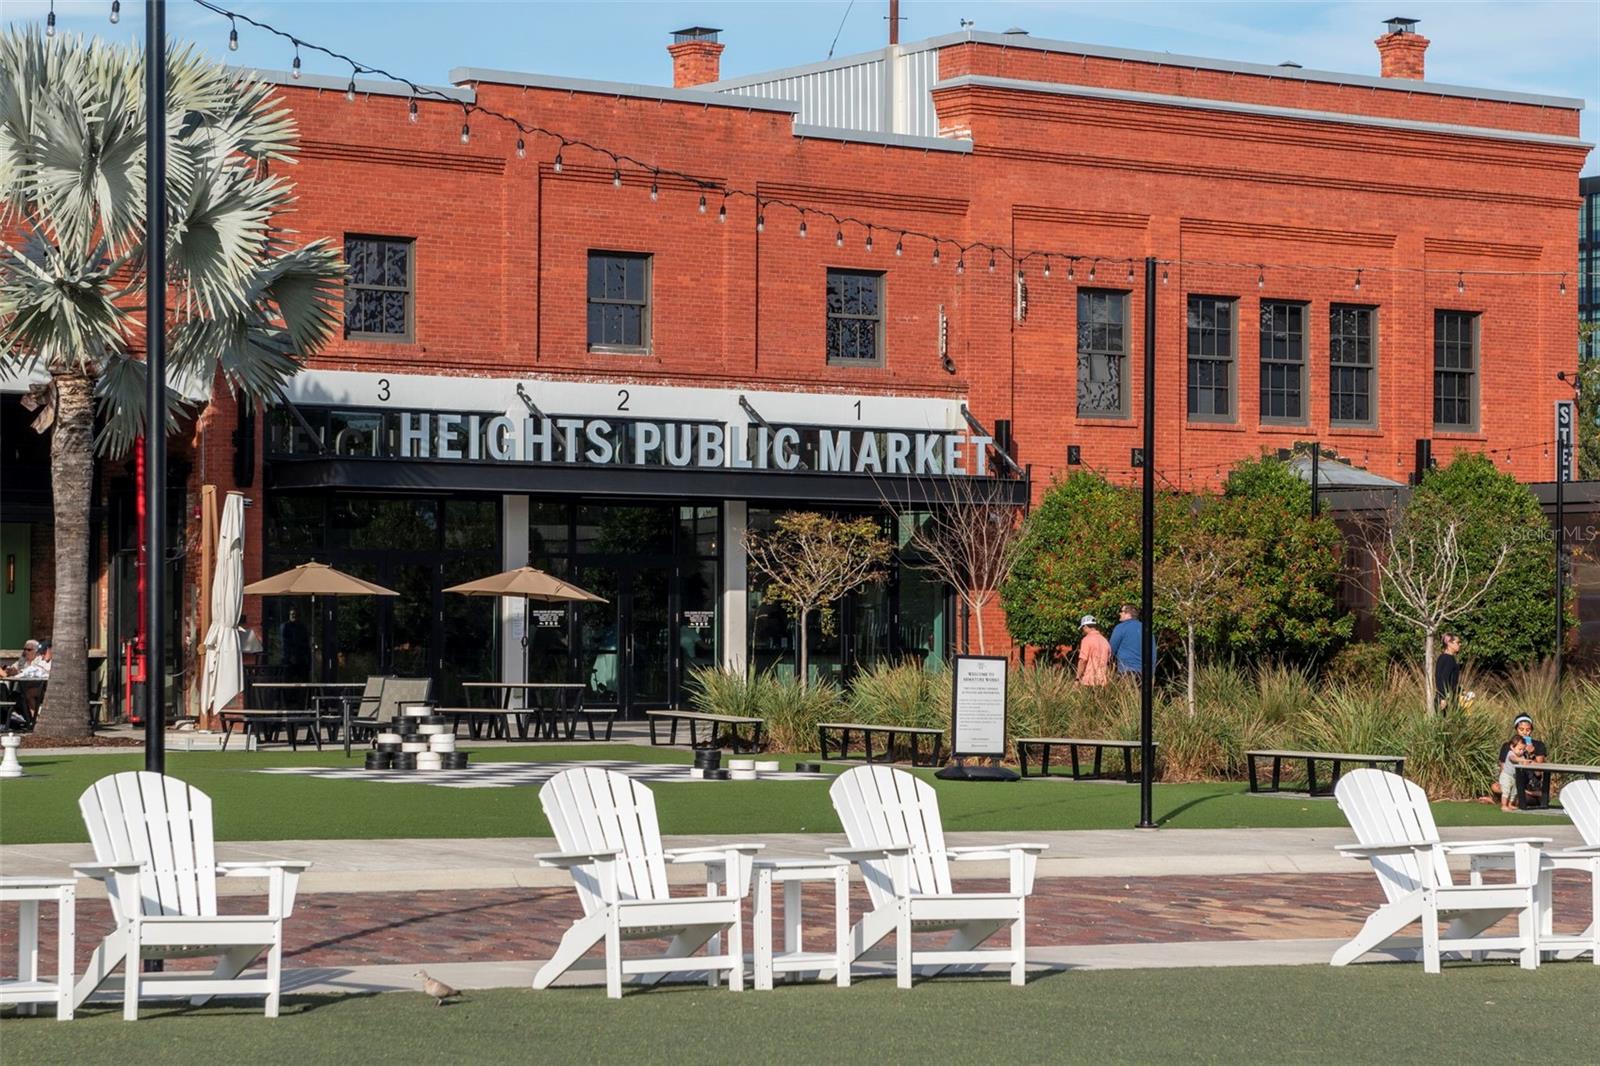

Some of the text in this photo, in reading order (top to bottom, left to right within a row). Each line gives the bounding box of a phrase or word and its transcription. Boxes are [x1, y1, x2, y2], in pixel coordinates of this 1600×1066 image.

[377, 378, 391, 402] 3
[616, 389, 631, 412] 2
[853, 399, 862, 421] 1
[399, 411, 994, 477] HEIGHTS PUBLIC MARKET
